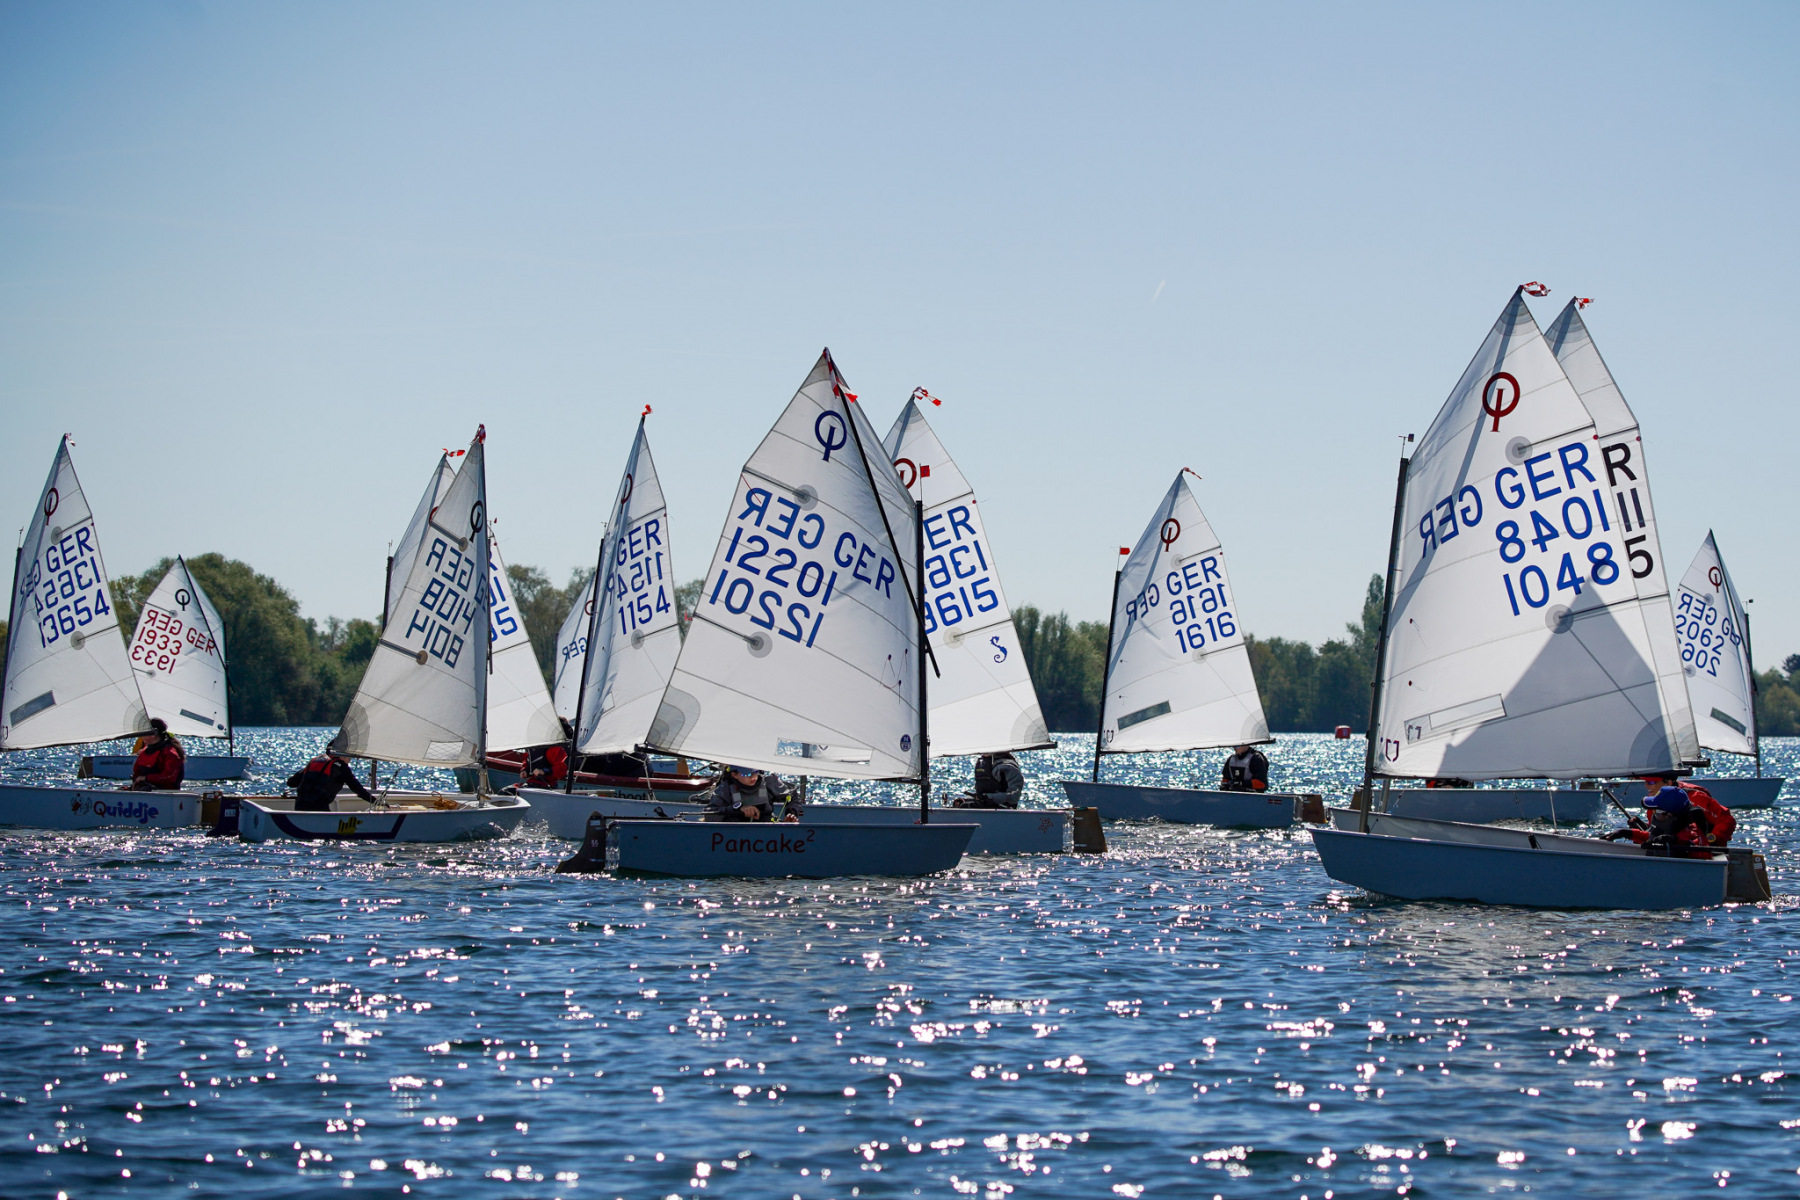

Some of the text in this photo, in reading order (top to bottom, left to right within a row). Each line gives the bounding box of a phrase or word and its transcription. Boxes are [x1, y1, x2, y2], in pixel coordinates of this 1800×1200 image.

[1494, 442, 1596, 509] GER
[46, 526, 95, 573] GER
[616, 519, 662, 567] GER
[923, 505, 976, 551] ER
[725, 526, 838, 607] 12201
[834, 531, 895, 600] GER
[1166, 556, 1222, 596] GER
[1503, 542, 1620, 617] 1048
[38, 588, 110, 649] 13654
[618, 585, 671, 635] 1154
[1174, 611, 1236, 654] 1616
[137, 626, 182, 656] 1933
[186, 627, 215, 657] GER
[1676, 614, 1725, 656] 2062
[93, 800, 159, 825] Quiddje
